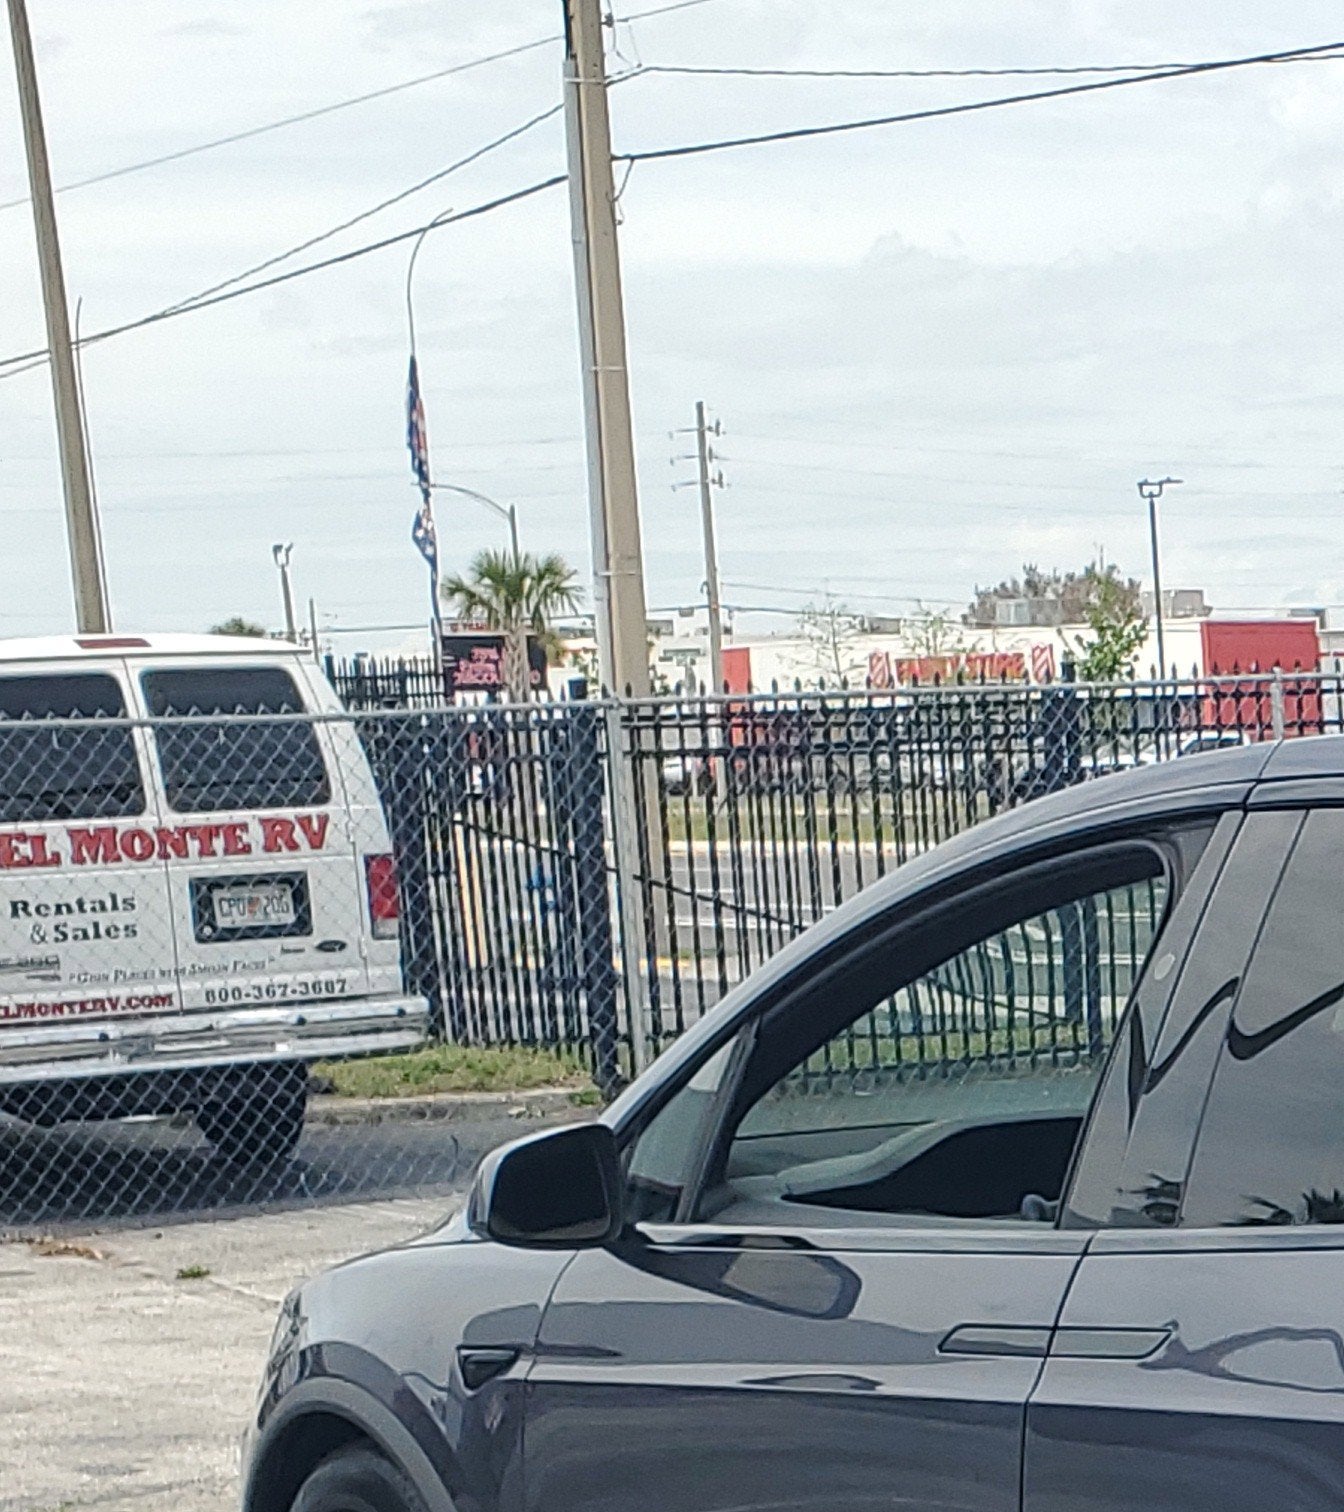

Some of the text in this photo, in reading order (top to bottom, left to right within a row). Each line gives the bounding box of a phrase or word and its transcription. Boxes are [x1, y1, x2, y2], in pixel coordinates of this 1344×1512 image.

[66, 822, 252, 865] MONTE
[260, 813, 330, 852] RV
[9, 892, 137, 919] Rentals
[53, 921, 138, 943] Sales
